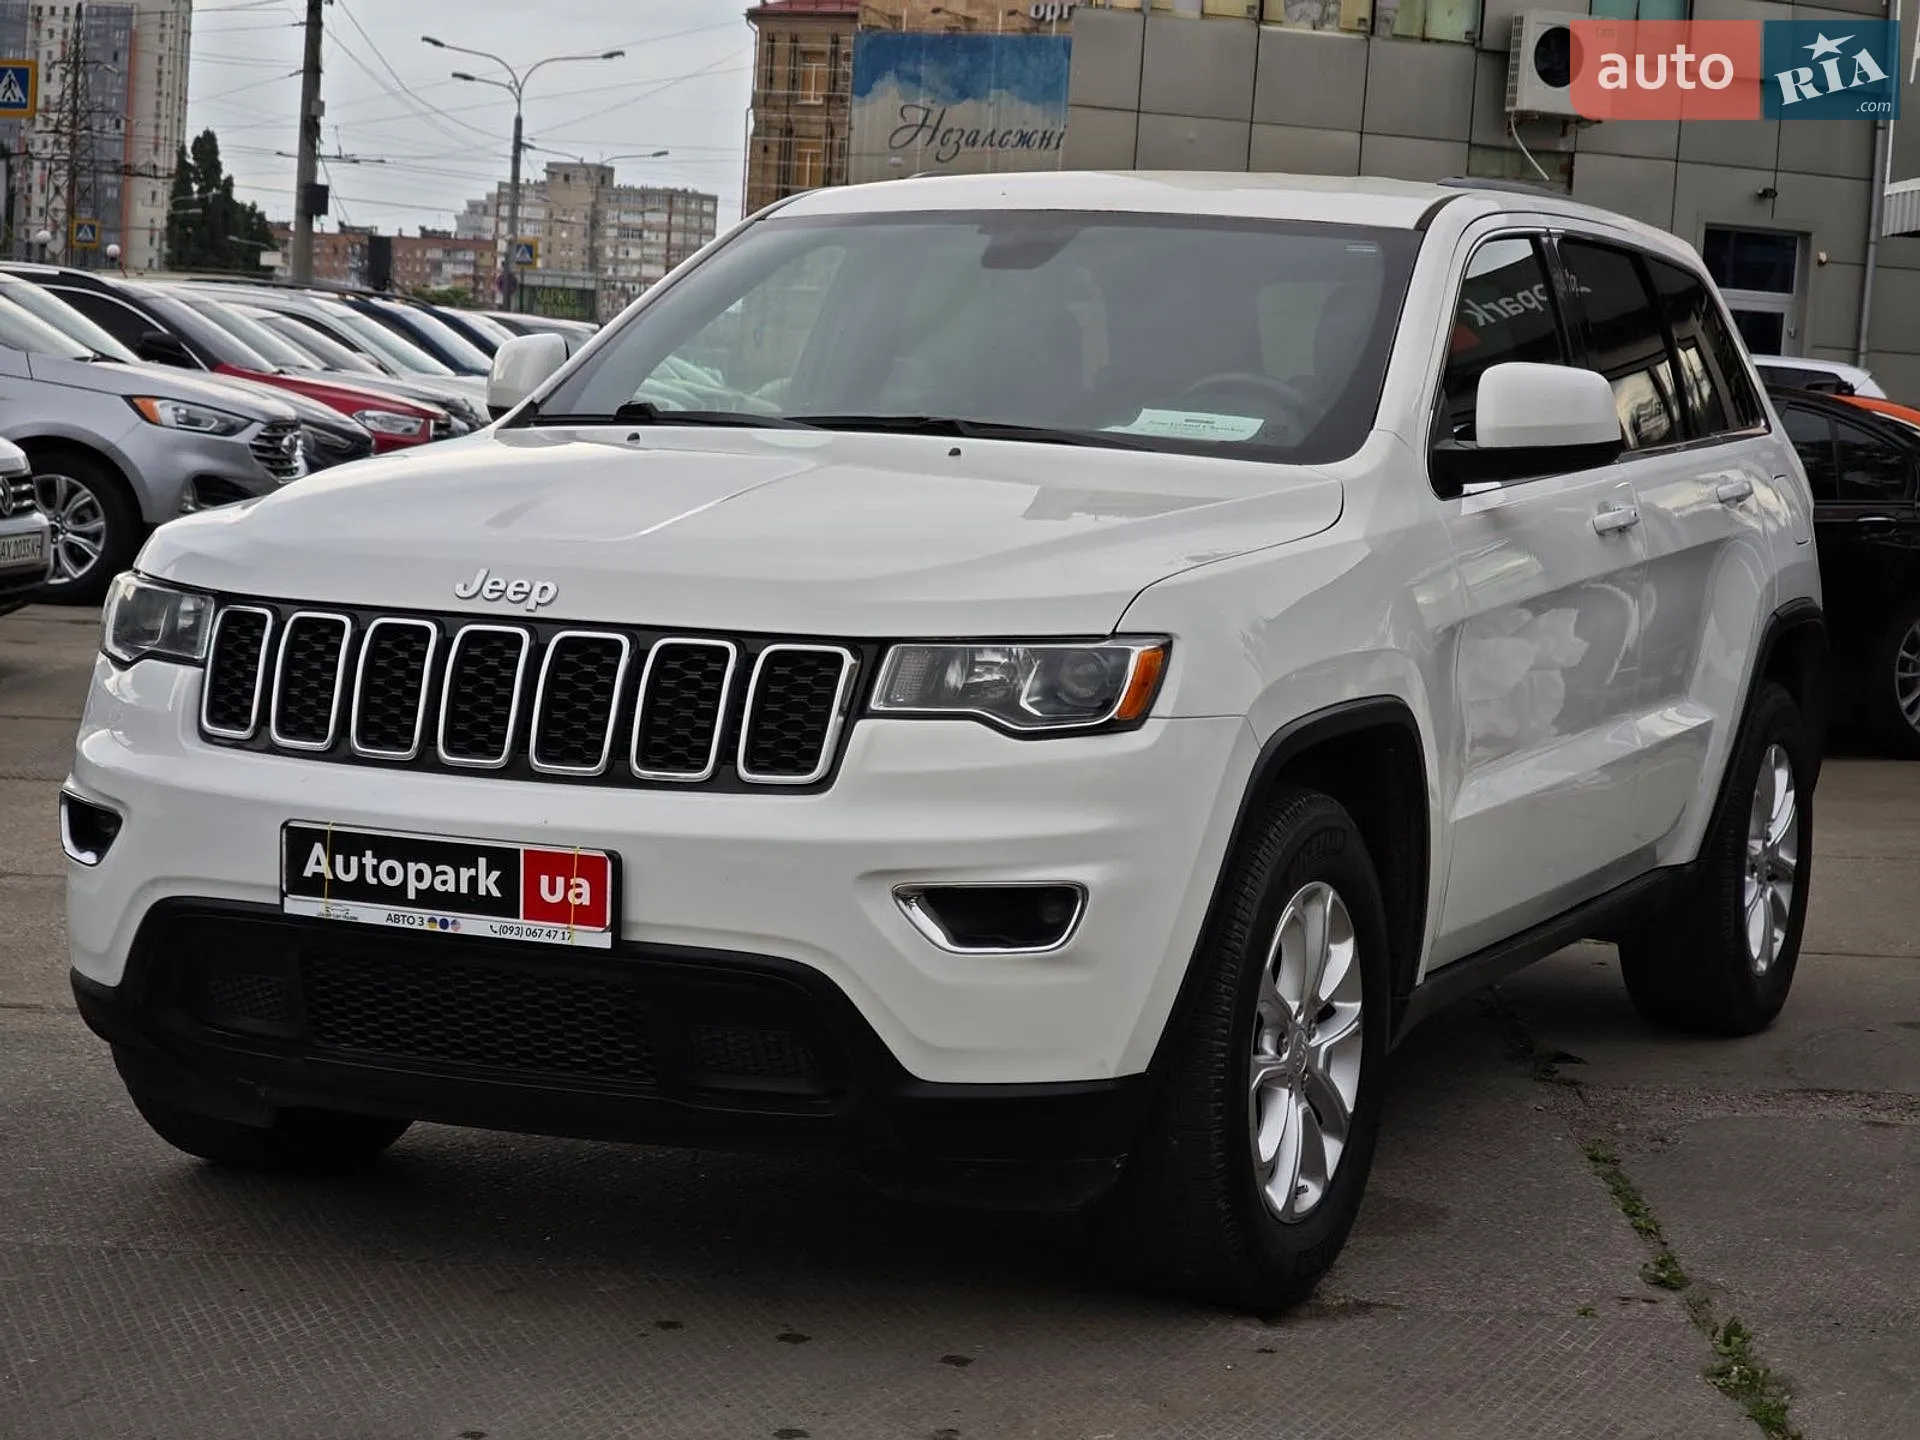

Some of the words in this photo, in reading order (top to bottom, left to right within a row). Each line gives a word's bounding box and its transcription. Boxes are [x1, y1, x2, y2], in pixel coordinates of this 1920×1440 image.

[889, 103, 1067, 164] Незалежні
[454, 567, 559, 613] Jeep
[302, 841, 504, 900] Autopark
[539, 874, 592, 907] ua
[499, 924, 524, 938] (093)
[525, 927, 544, 939] 067
[545, 930, 559, 941] 47
